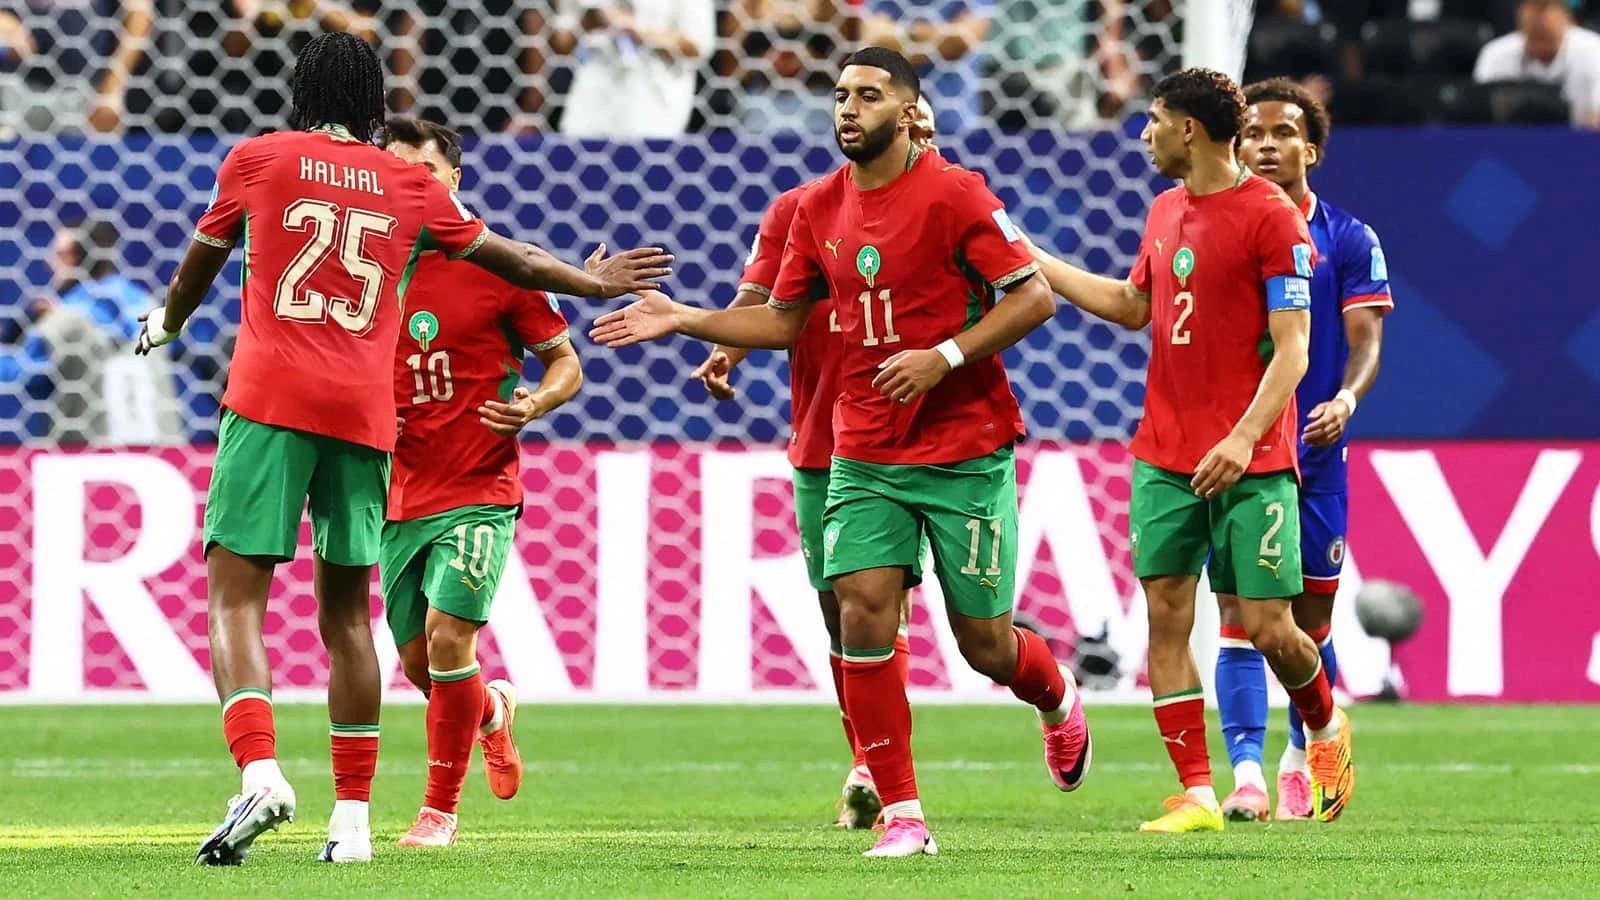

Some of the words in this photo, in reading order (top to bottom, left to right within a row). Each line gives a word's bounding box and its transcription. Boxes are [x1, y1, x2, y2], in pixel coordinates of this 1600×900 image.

[299, 156, 384, 195] HALHAL
[273, 198, 399, 337] 25
[858, 288, 900, 346] 11
[1171, 291, 1194, 345] 2
[406, 350, 454, 405] 10
[449, 522, 495, 578] 10
[960, 518, 1002, 576] 11
[1259, 502, 1284, 556] 2
